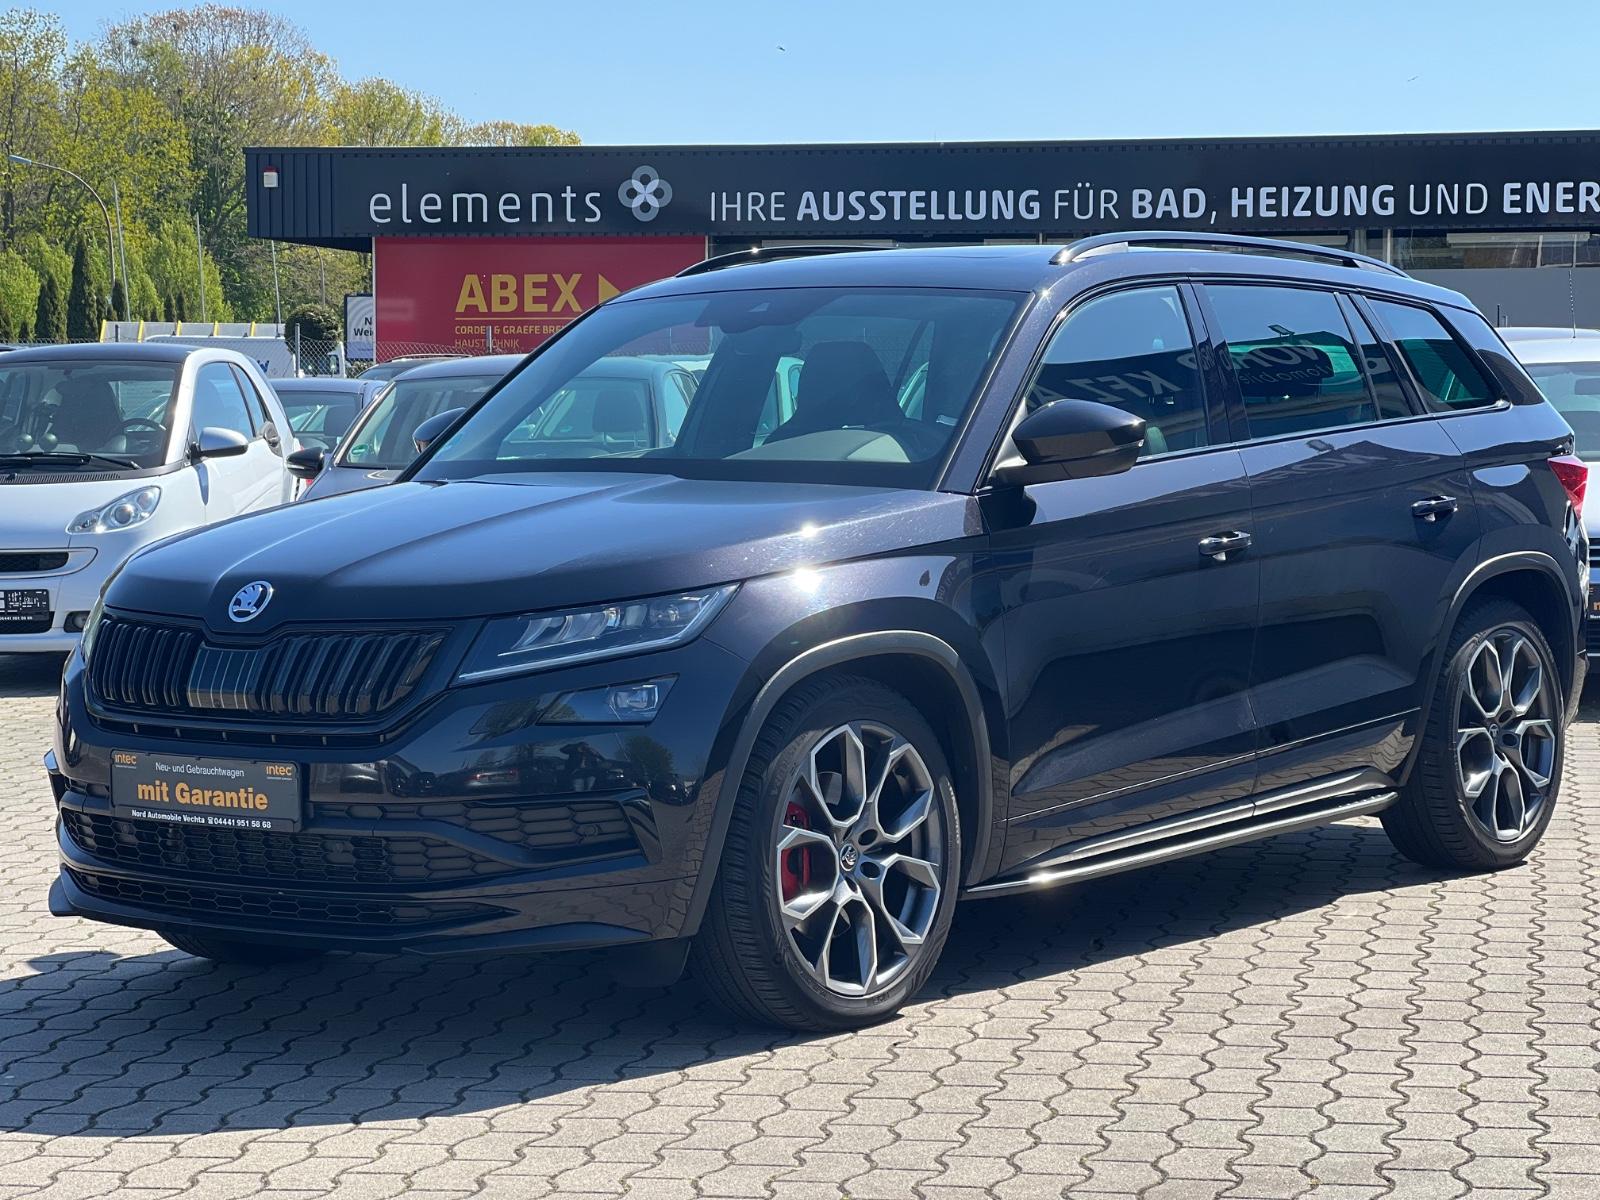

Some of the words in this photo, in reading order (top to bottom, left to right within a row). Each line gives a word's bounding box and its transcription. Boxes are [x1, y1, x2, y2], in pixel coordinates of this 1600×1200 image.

[369, 183, 601, 223] elements
[710, 191, 786, 222] IHRE
[796, 189, 1041, 221] AUSSTELLUNG
[1054, 182, 1119, 219] FÜR
[1131, 188, 1217, 224] BAD,
[1231, 184, 1395, 218] HEIZUNG
[1409, 183, 1488, 215] UND
[1503, 181, 1600, 213] ENER
[455, 273, 583, 313] ABEX
[454, 325, 488, 335] CORDE
[494, 325, 501, 335] &
[503, 325, 541, 335] GRAEFE
[455, 338, 520, 348] HAUSTCHNIK
[115, 753, 137, 765] intec
[155, 762, 171, 772] Neu-
[172, 763, 185, 773] und
[186, 764, 245, 779] Gebrauchtwagen
[266, 765, 292, 776] intec
[137, 780, 169, 802] mit
[175, 782, 269, 810] Garantie
[131, 809, 146, 818] Nord
[147, 811, 182, 822] Automobile
[183, 815, 205, 823] Vechta
[214, 818, 235, 826] 04441
[237, 819, 249, 827] 951
[251, 820, 260, 828] 58
[262, 821, 271, 829] 68
